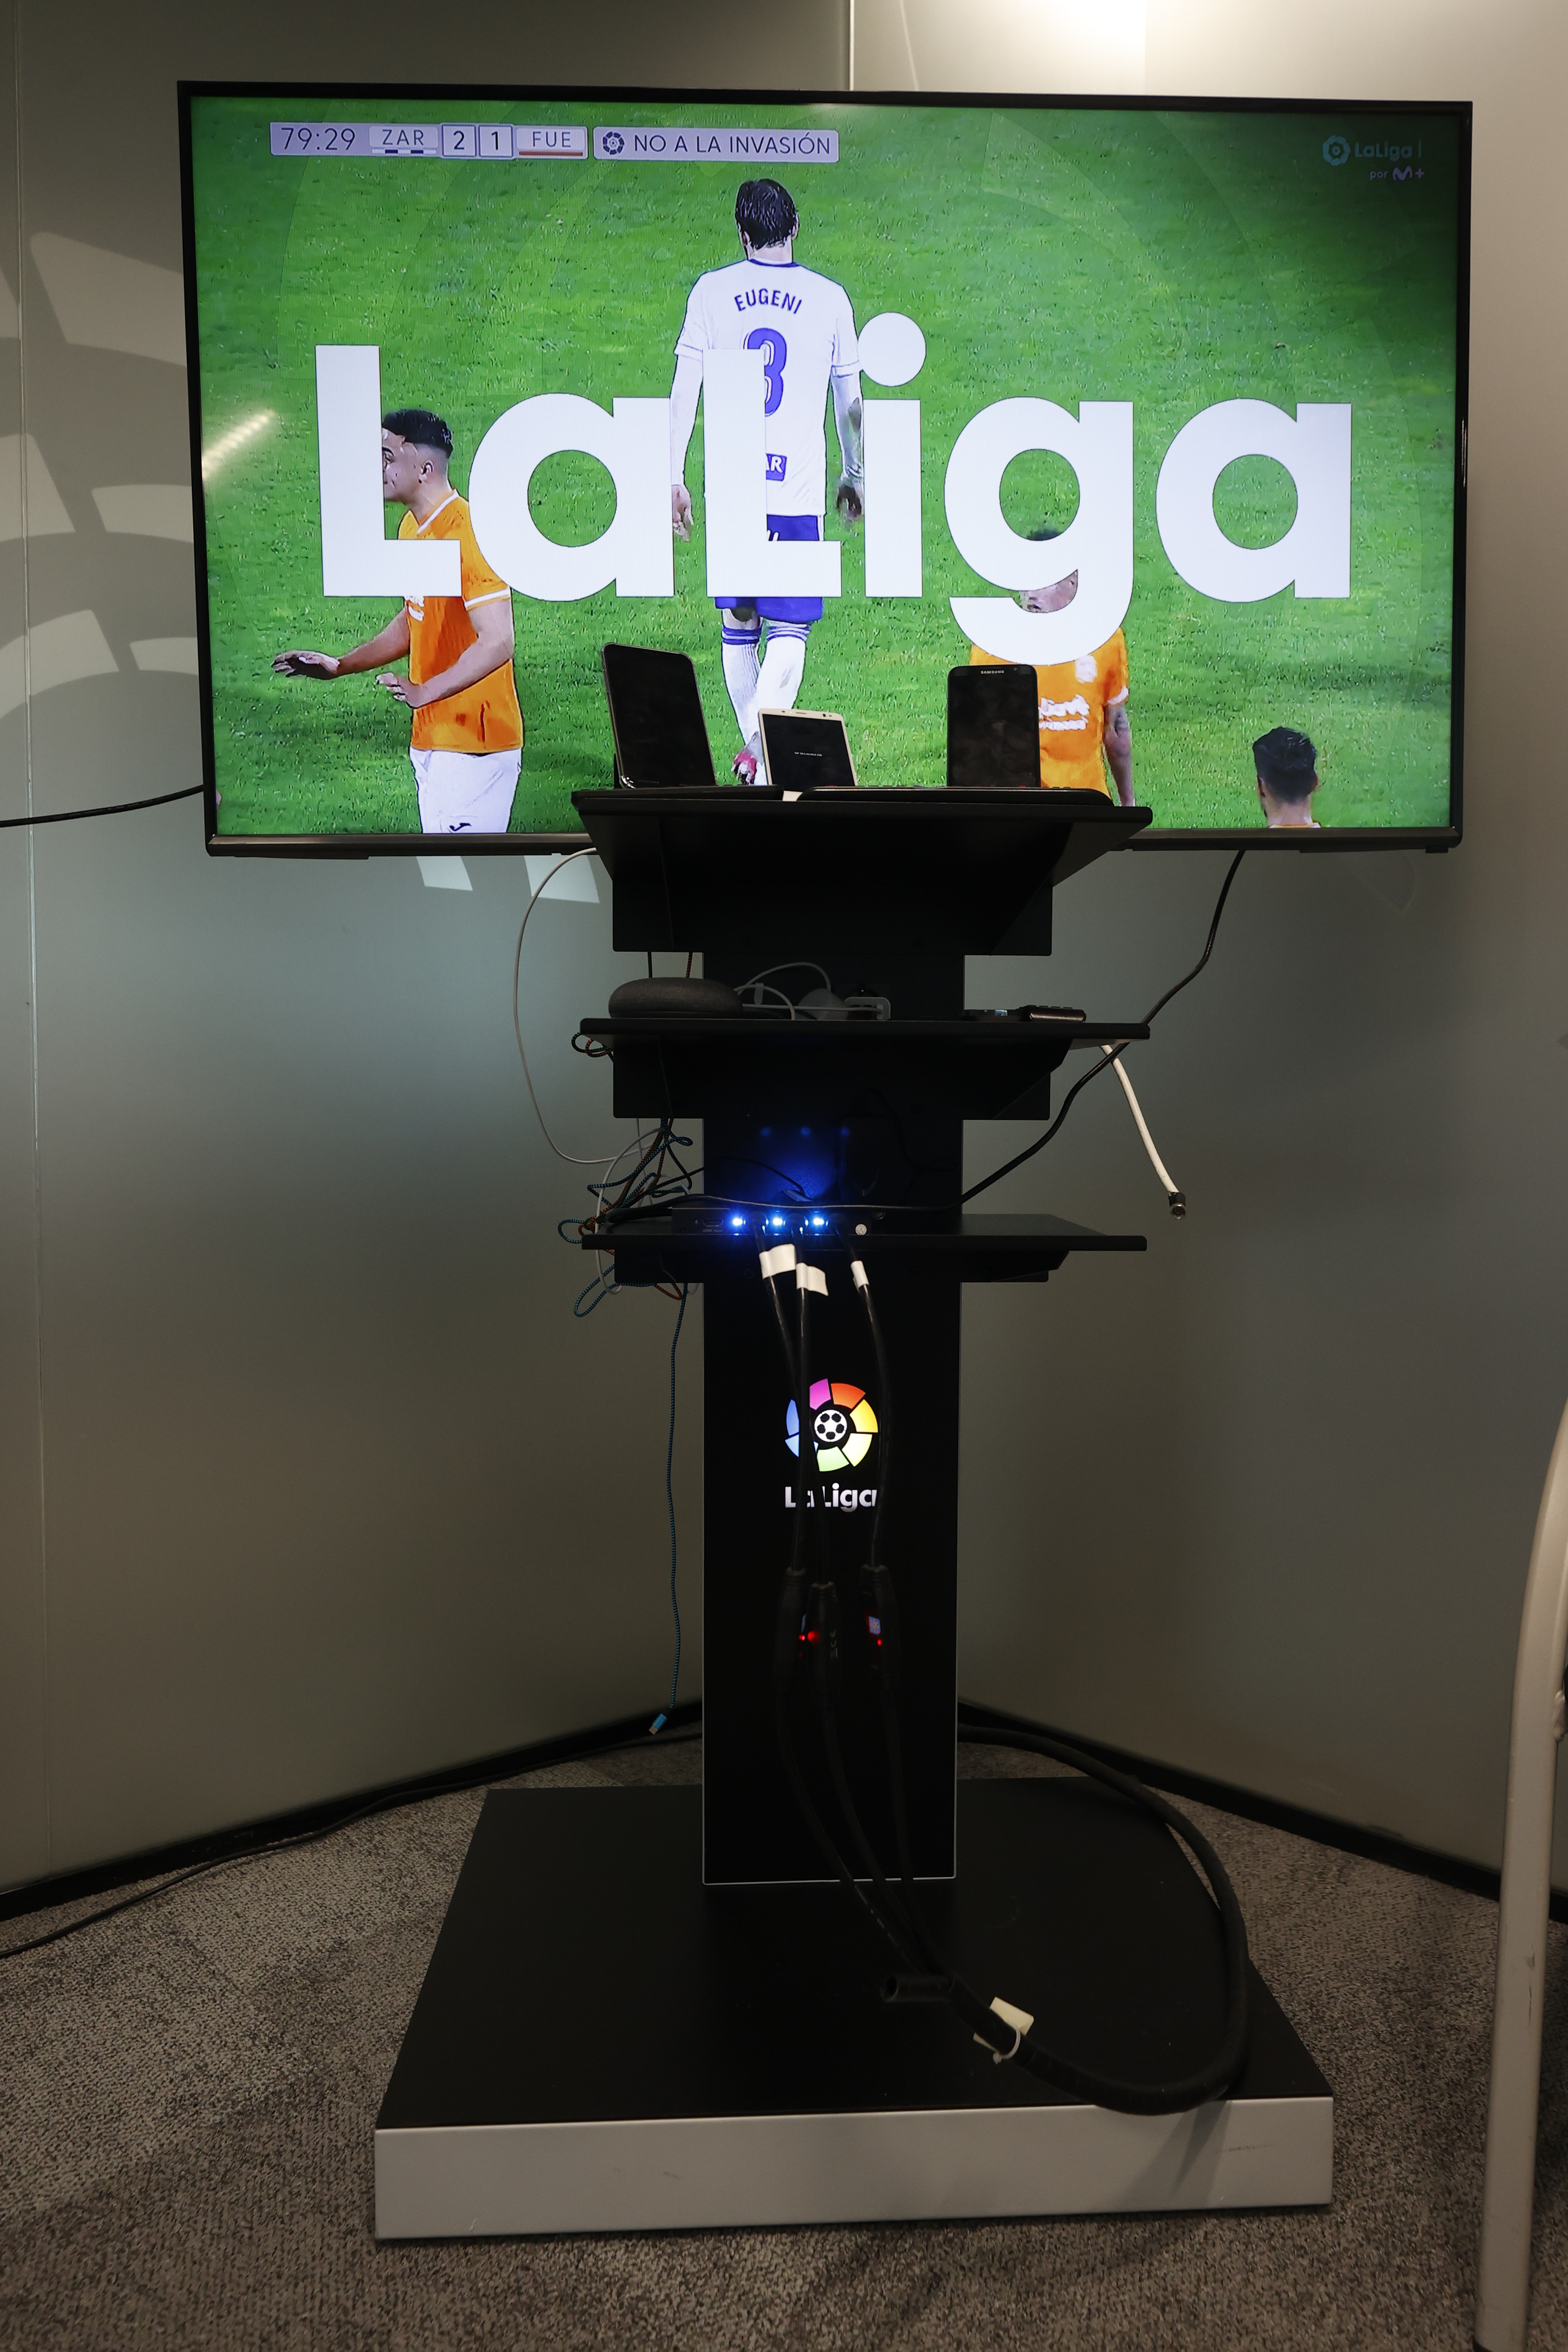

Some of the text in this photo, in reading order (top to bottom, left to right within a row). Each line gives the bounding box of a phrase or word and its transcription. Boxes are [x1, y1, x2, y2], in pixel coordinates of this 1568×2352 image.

[280, 127, 571, 151] 79:29 ZAR 2 1 FUE
[634, 131, 830, 154] NO A LA INVASIÓN
[1354, 141, 1412, 161] LaLiga
[1369, 170, 1388, 181] por
[734, 288, 802, 314] EUGENI
[316, 313, 1352, 664] LaLiga
[785, 1482, 877, 1512] Liga
